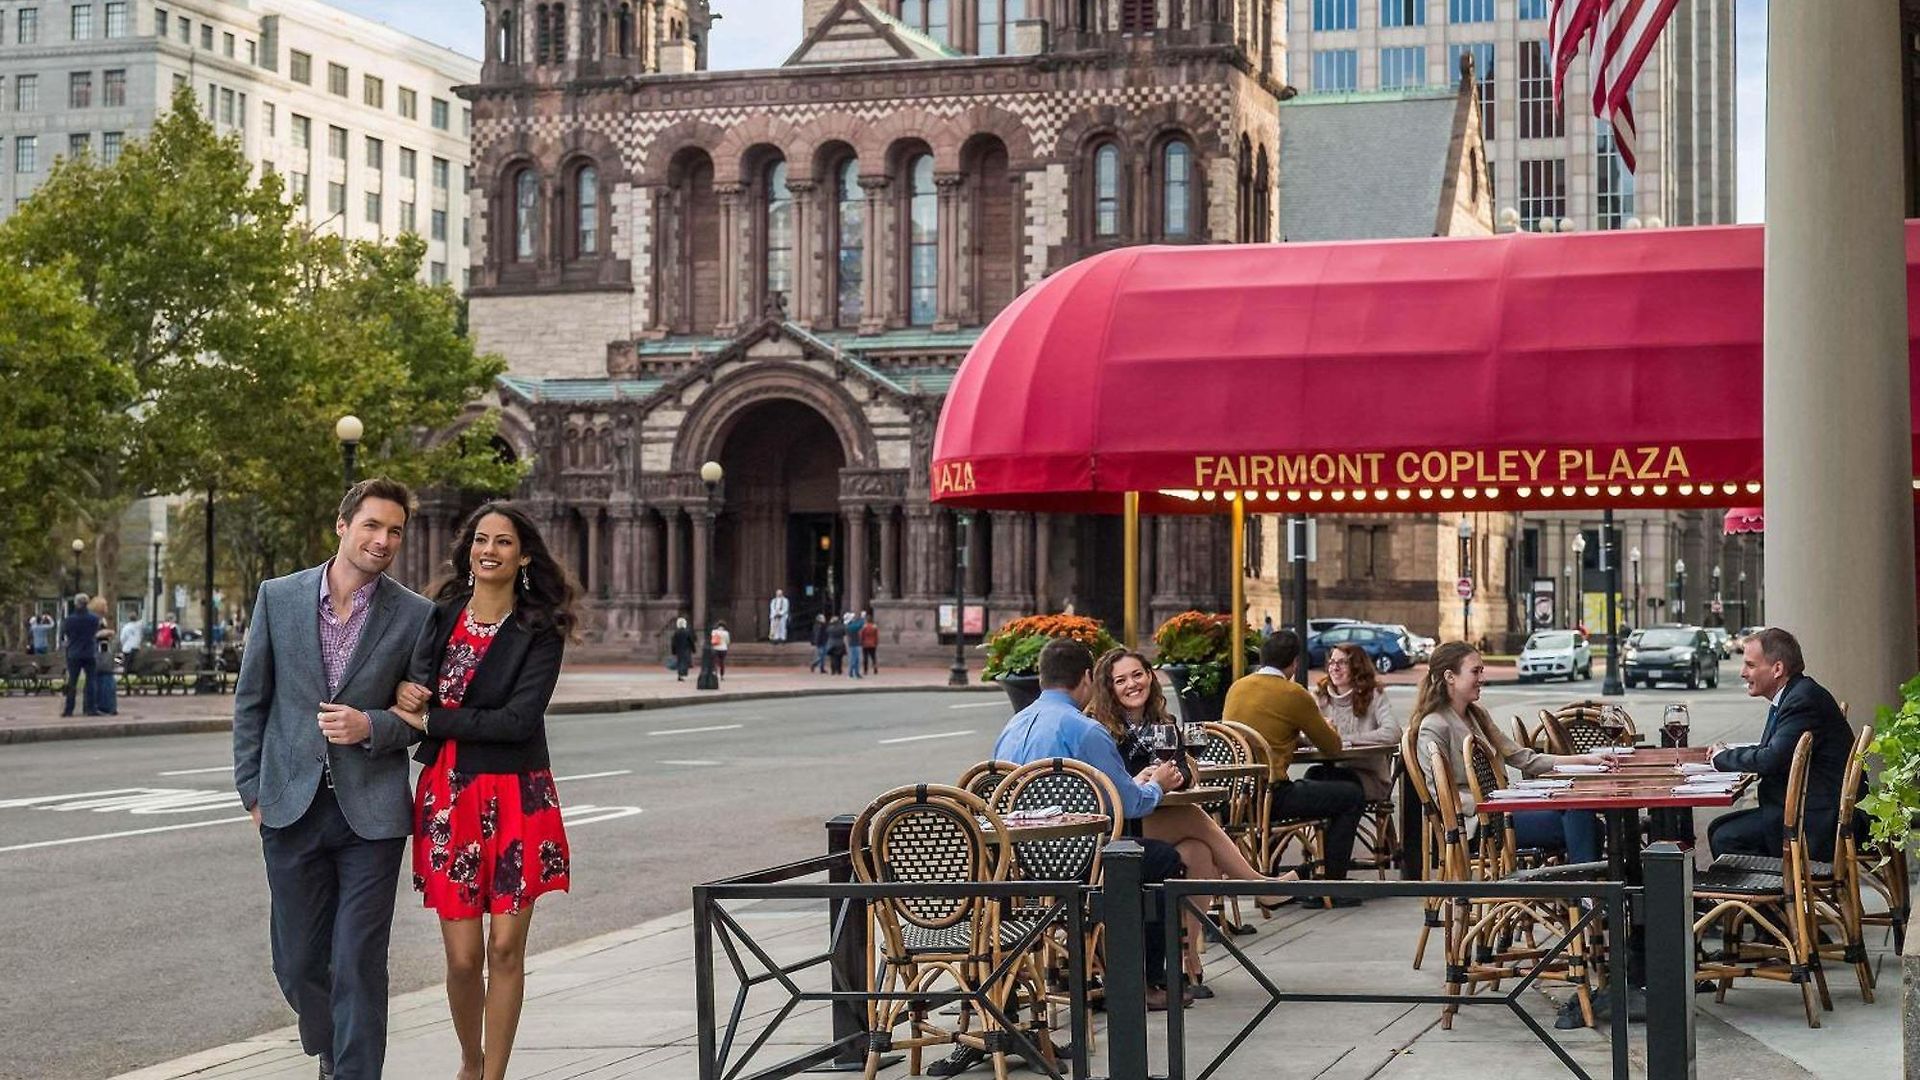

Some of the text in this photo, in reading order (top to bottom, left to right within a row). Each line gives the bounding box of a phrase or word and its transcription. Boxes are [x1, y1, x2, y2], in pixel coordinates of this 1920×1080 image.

[1195, 446, 1690, 486] FAIRMONT COPLEY PLAZA
